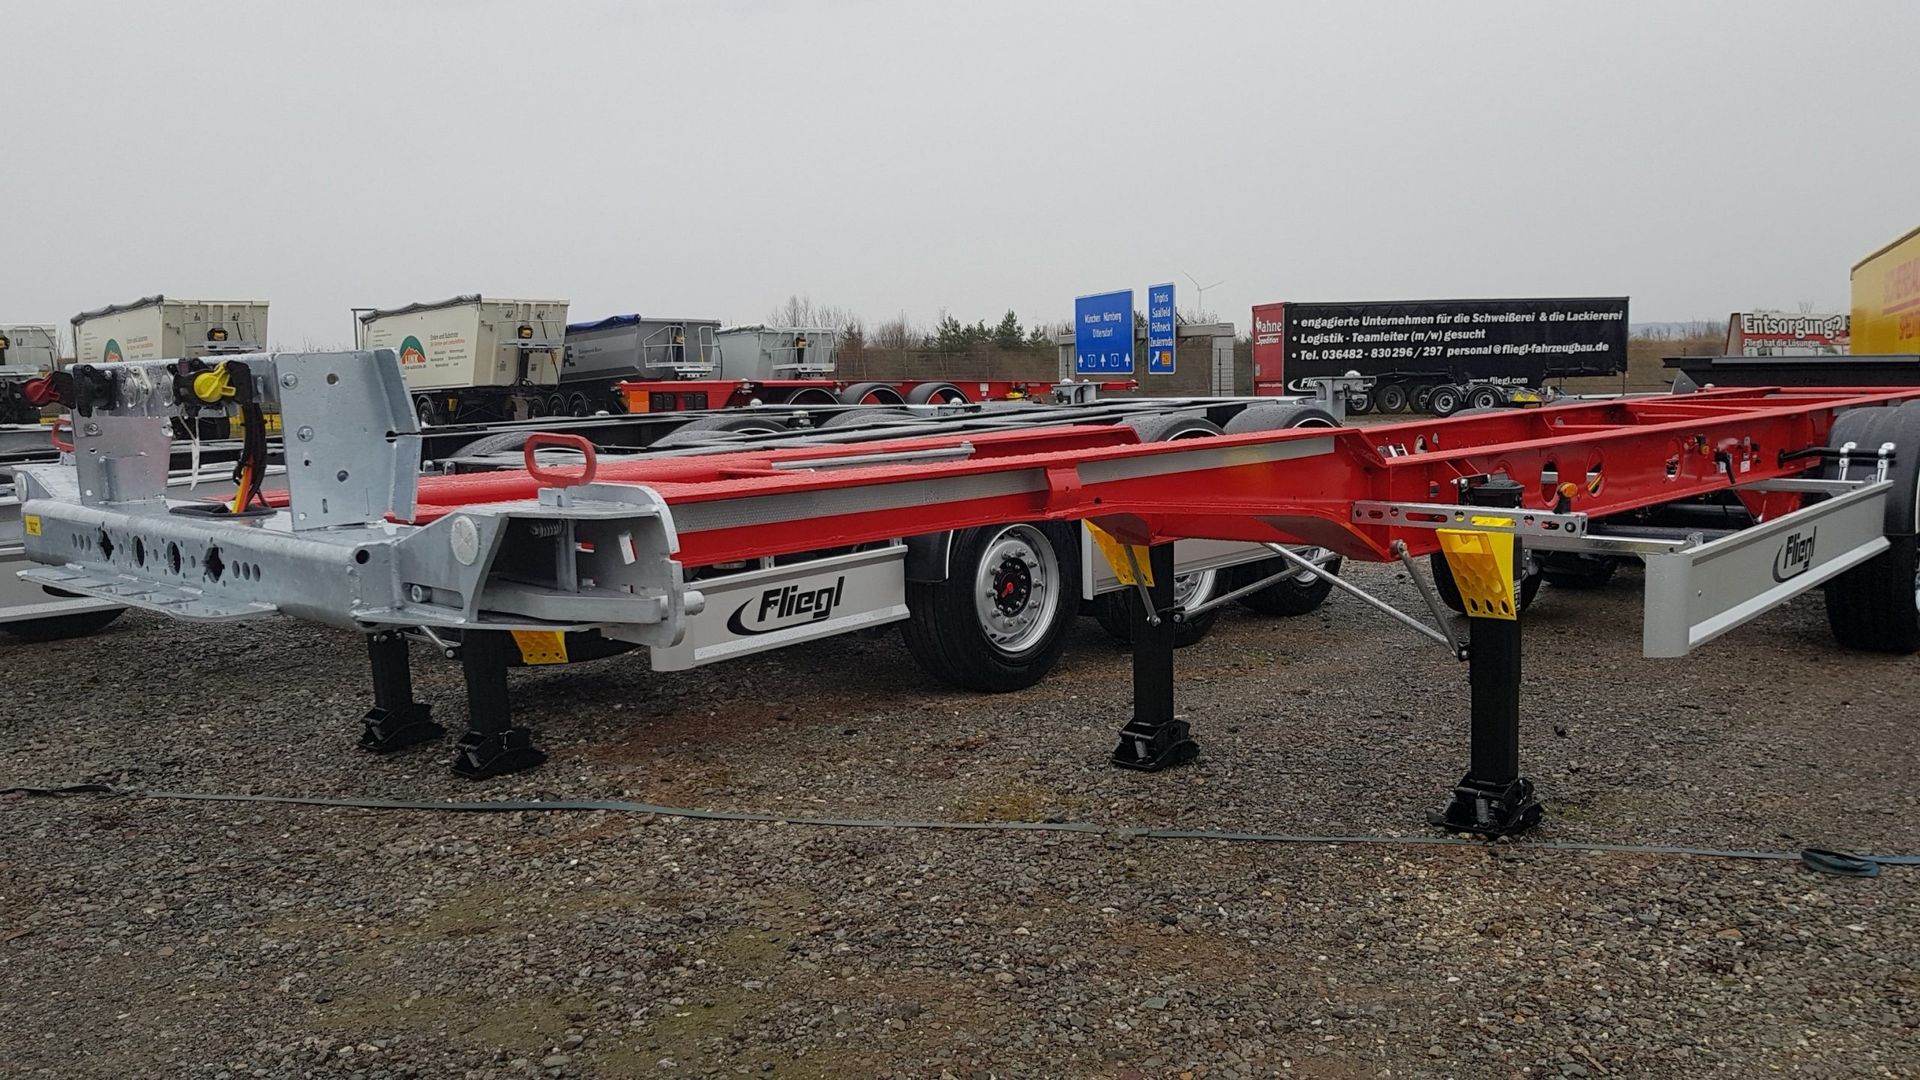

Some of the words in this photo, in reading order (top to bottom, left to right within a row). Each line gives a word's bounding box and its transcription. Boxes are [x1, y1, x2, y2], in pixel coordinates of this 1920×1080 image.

[1152, 307, 1171, 318] Saalfeld
[1301, 317, 1360, 329] engagierte
[1362, 315, 1435, 327] Unternehmen
[1436, 313, 1452, 324] für
[1454, 313, 1470, 323] die
[1472, 311, 1535, 323] Schweißerei
[1539, 312, 1548, 321] &
[1549, 311, 1565, 321] die
[1567, 310, 1623, 321] Lackiererei
[1151, 322, 1171, 333] Pößneck
[1743, 314, 1842, 339] Entsorgung?
[1301, 334, 1344, 345] Logistik
[1352, 332, 1409, 343] Teamleiter
[1410, 330, 1443, 342] (m/w)
[1443, 329, 1486, 342] gesucht
[1300, 350, 1319, 360] Tel.
[1322, 349, 1363, 360] 036482
[1423, 346, 1443, 357] 297
[1447, 342, 1609, 357] personal@fliegl-fahrzeugbau.de
[1783, 526, 1817, 569] Fliegl
[757, 576, 845, 622] Fliegl
